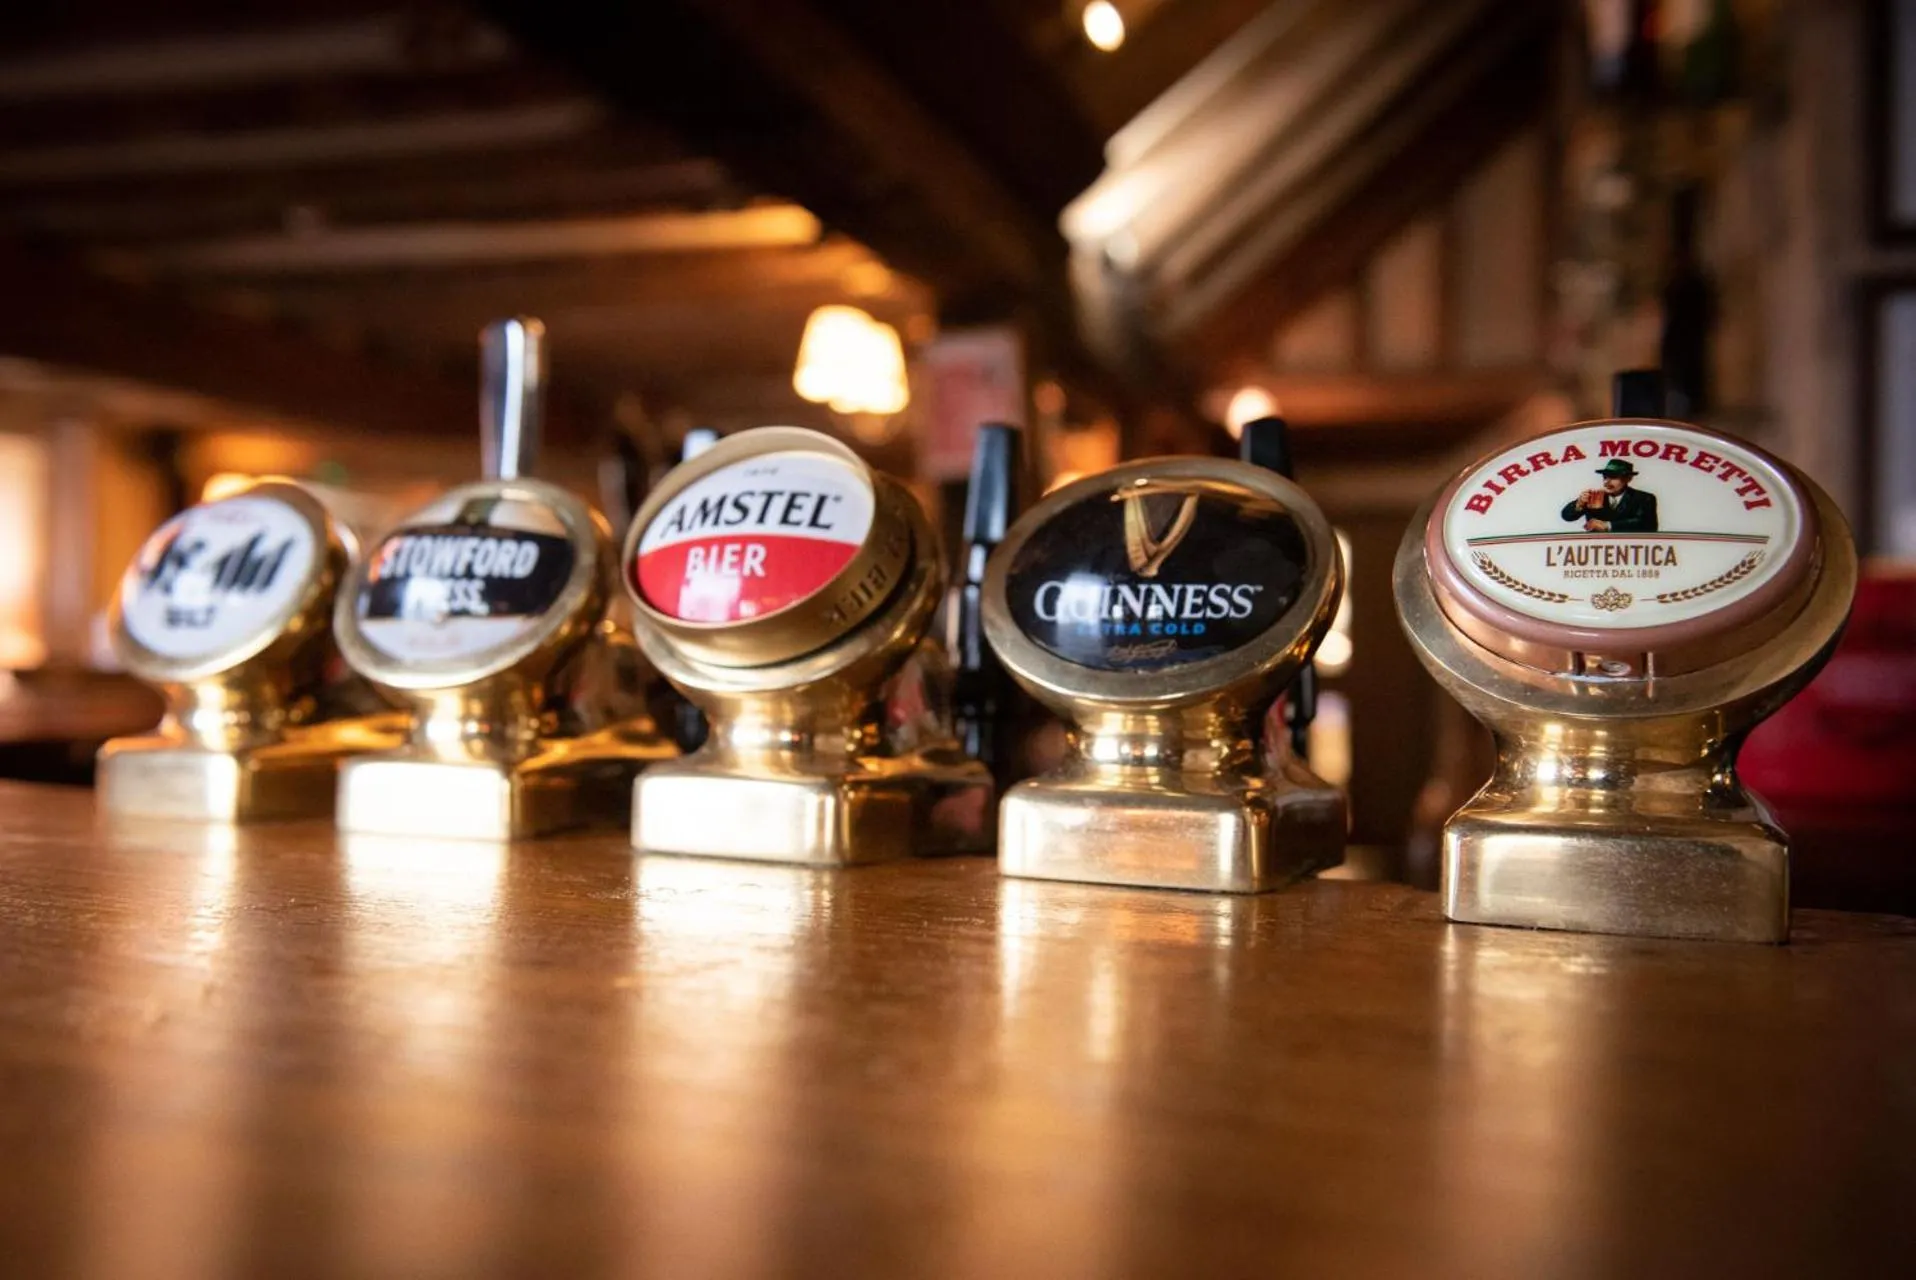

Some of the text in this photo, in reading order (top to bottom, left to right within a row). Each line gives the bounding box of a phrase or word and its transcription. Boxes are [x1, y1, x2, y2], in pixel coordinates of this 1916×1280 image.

[1465, 440, 1772, 515] BIRRA MORETTI
[660, 490, 834, 539] AMSTEL
[379, 535, 540, 578] STOWFORD
[685, 543, 767, 577] BIER
[1545, 544, 1678, 567] L'AUTENTICA
[1563, 568, 1610, 579] RICETTA
[1611, 568, 1634, 579] DAL
[1149, 621, 1207, 636] COLD
